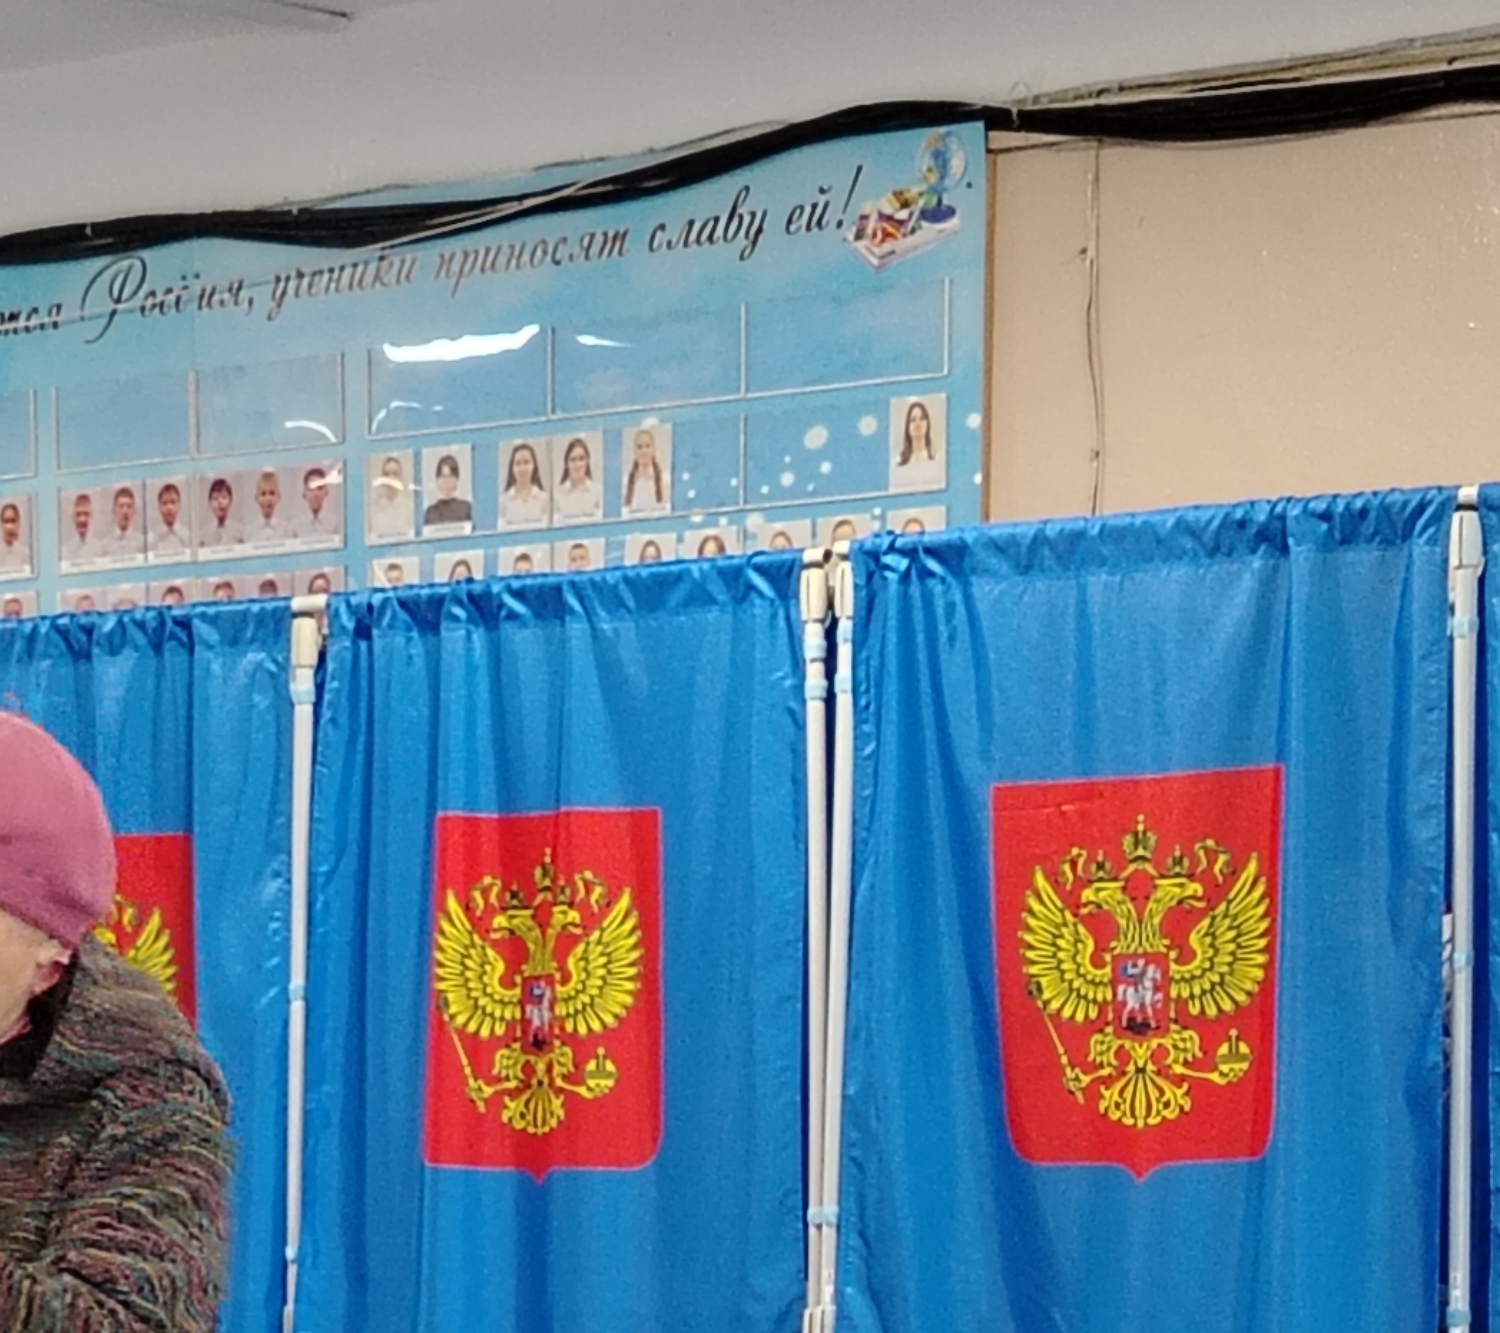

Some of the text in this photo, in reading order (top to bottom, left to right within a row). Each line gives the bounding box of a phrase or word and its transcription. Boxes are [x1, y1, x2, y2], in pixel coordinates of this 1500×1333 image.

[80, 255, 254, 345] Россия,
[267, 247, 417, 322] ученики
[434, 227, 630, 298] приносят
[648, 185, 768, 262] славу
[785, 164, 863, 236] ей!
